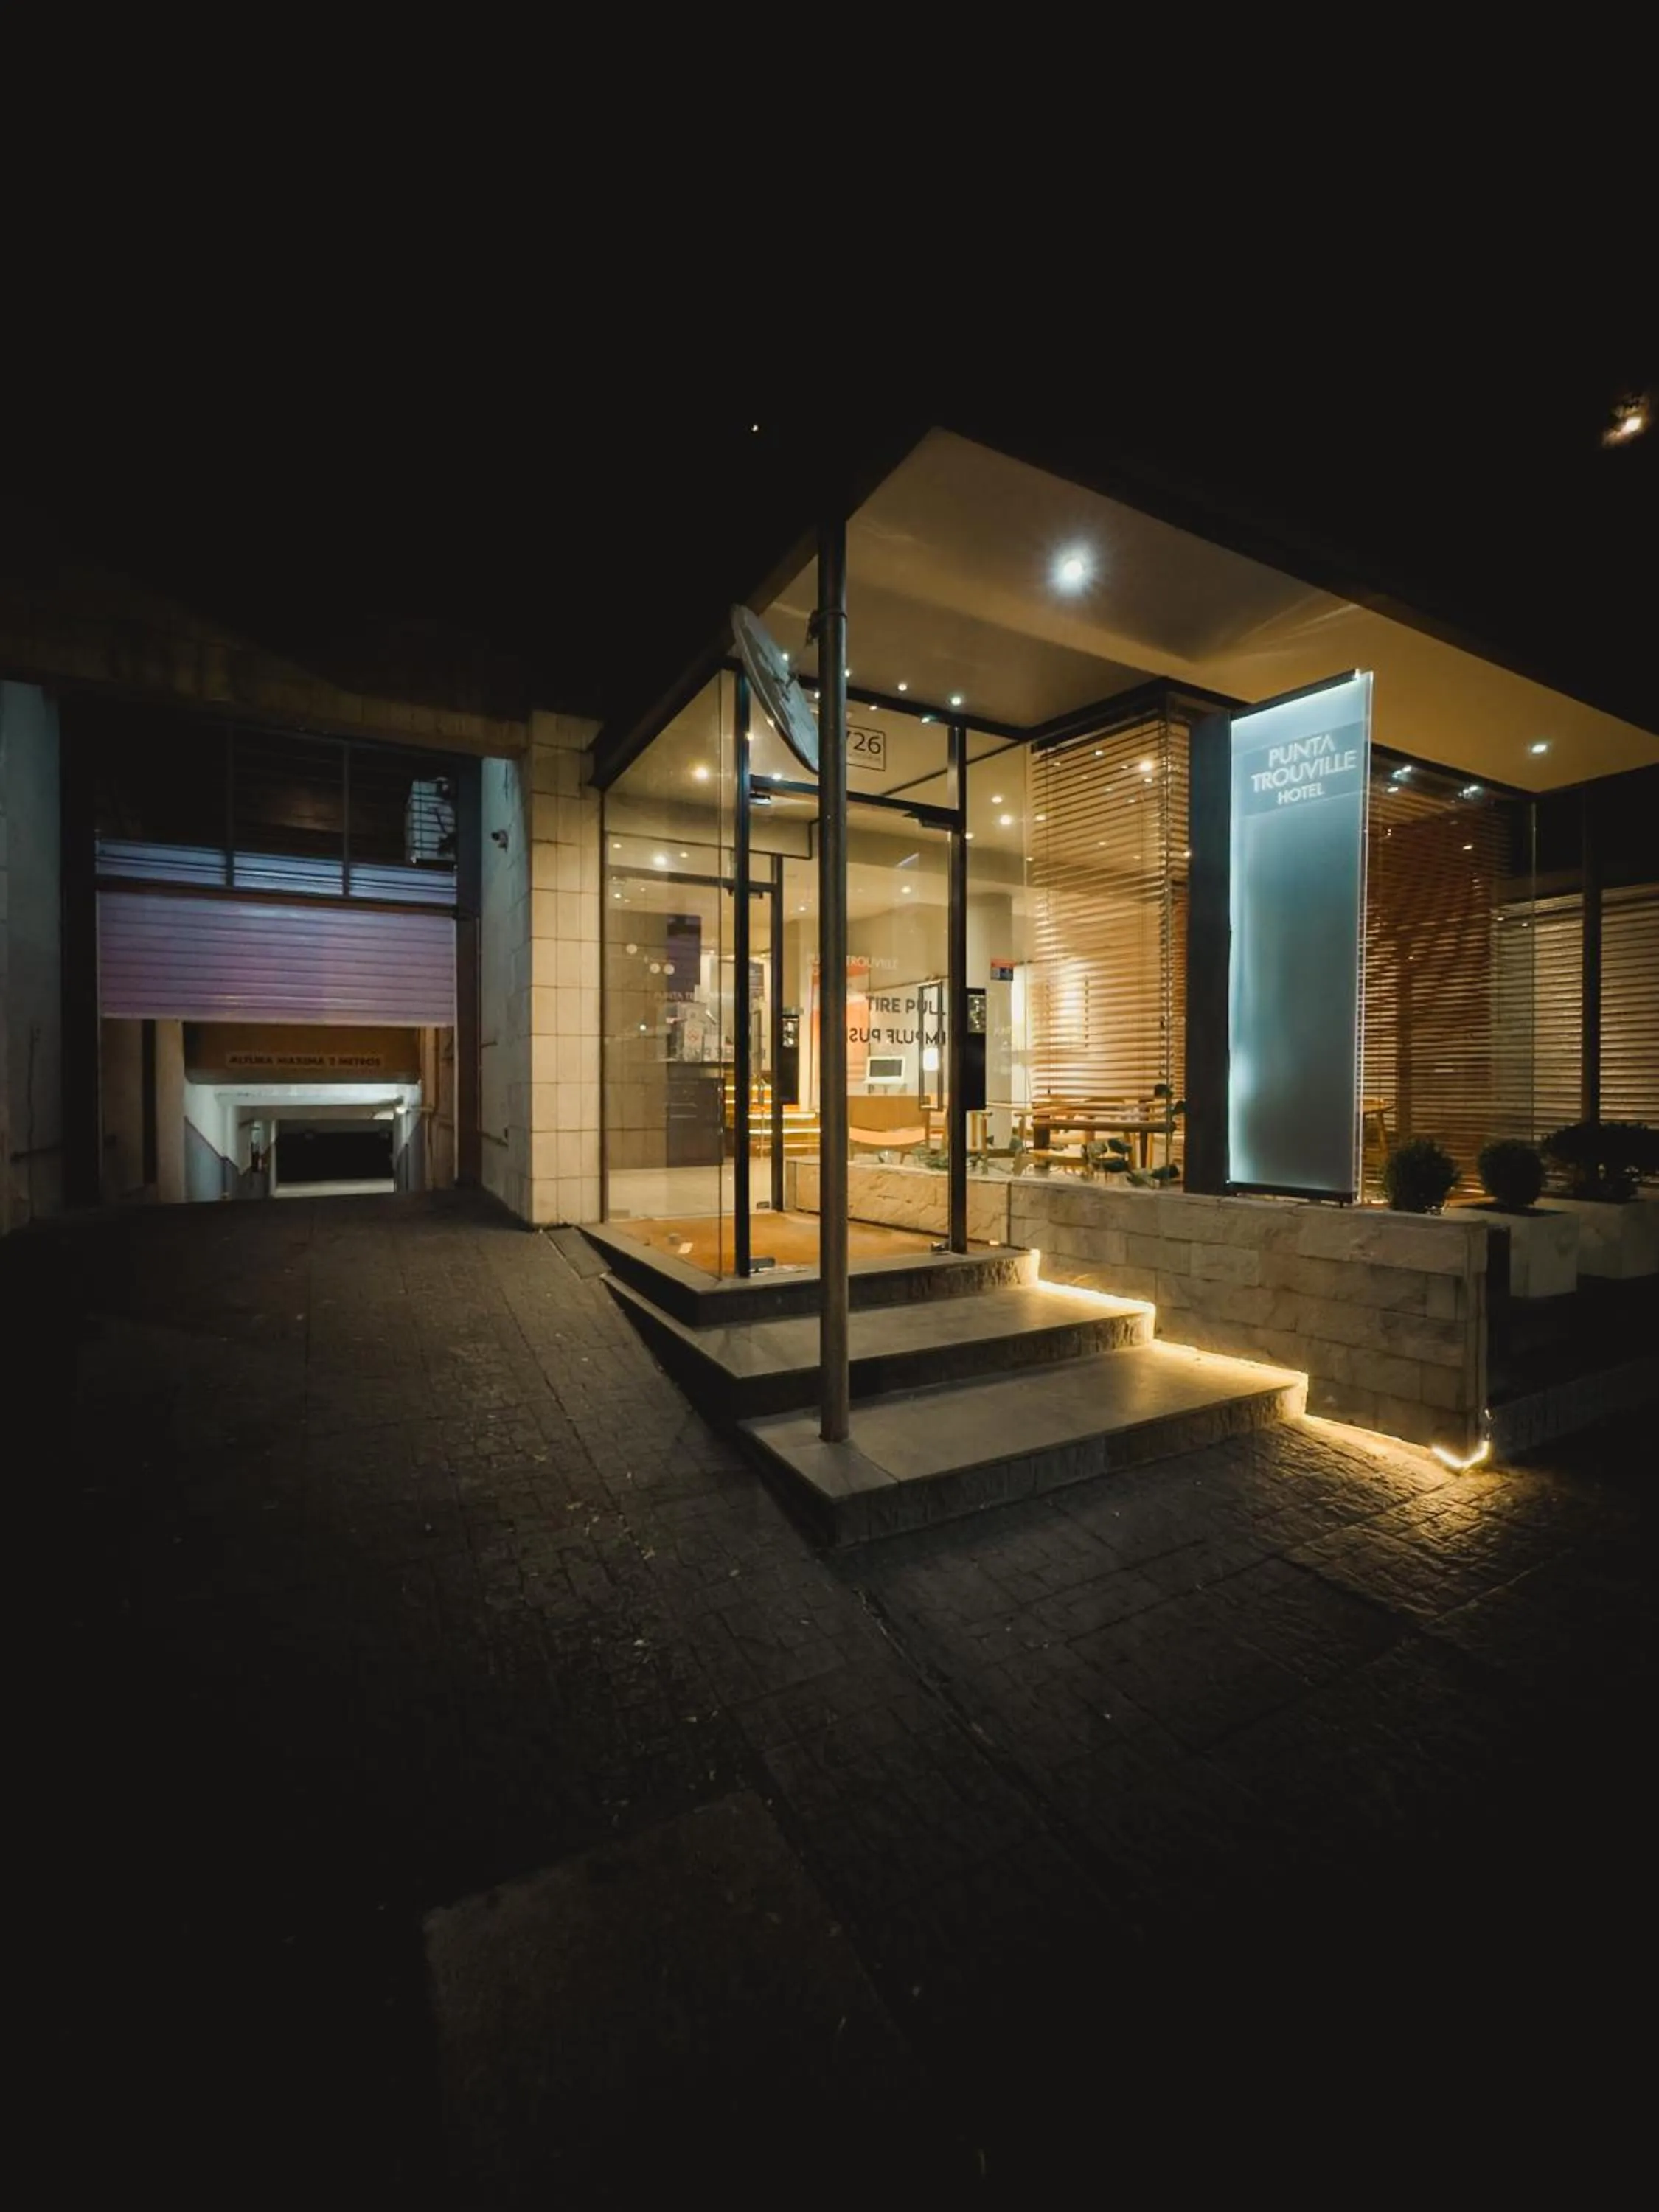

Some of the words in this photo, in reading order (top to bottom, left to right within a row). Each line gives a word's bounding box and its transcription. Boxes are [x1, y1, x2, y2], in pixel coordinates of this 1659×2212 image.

[1268, 734, 1335, 768] PUNTA
[1251, 749, 1357, 792] TROUVILLE
[1277, 783, 1325, 805] HOTEL
[866, 995, 901, 1013] TIRE
[338, 1057, 381, 1068] METROS
